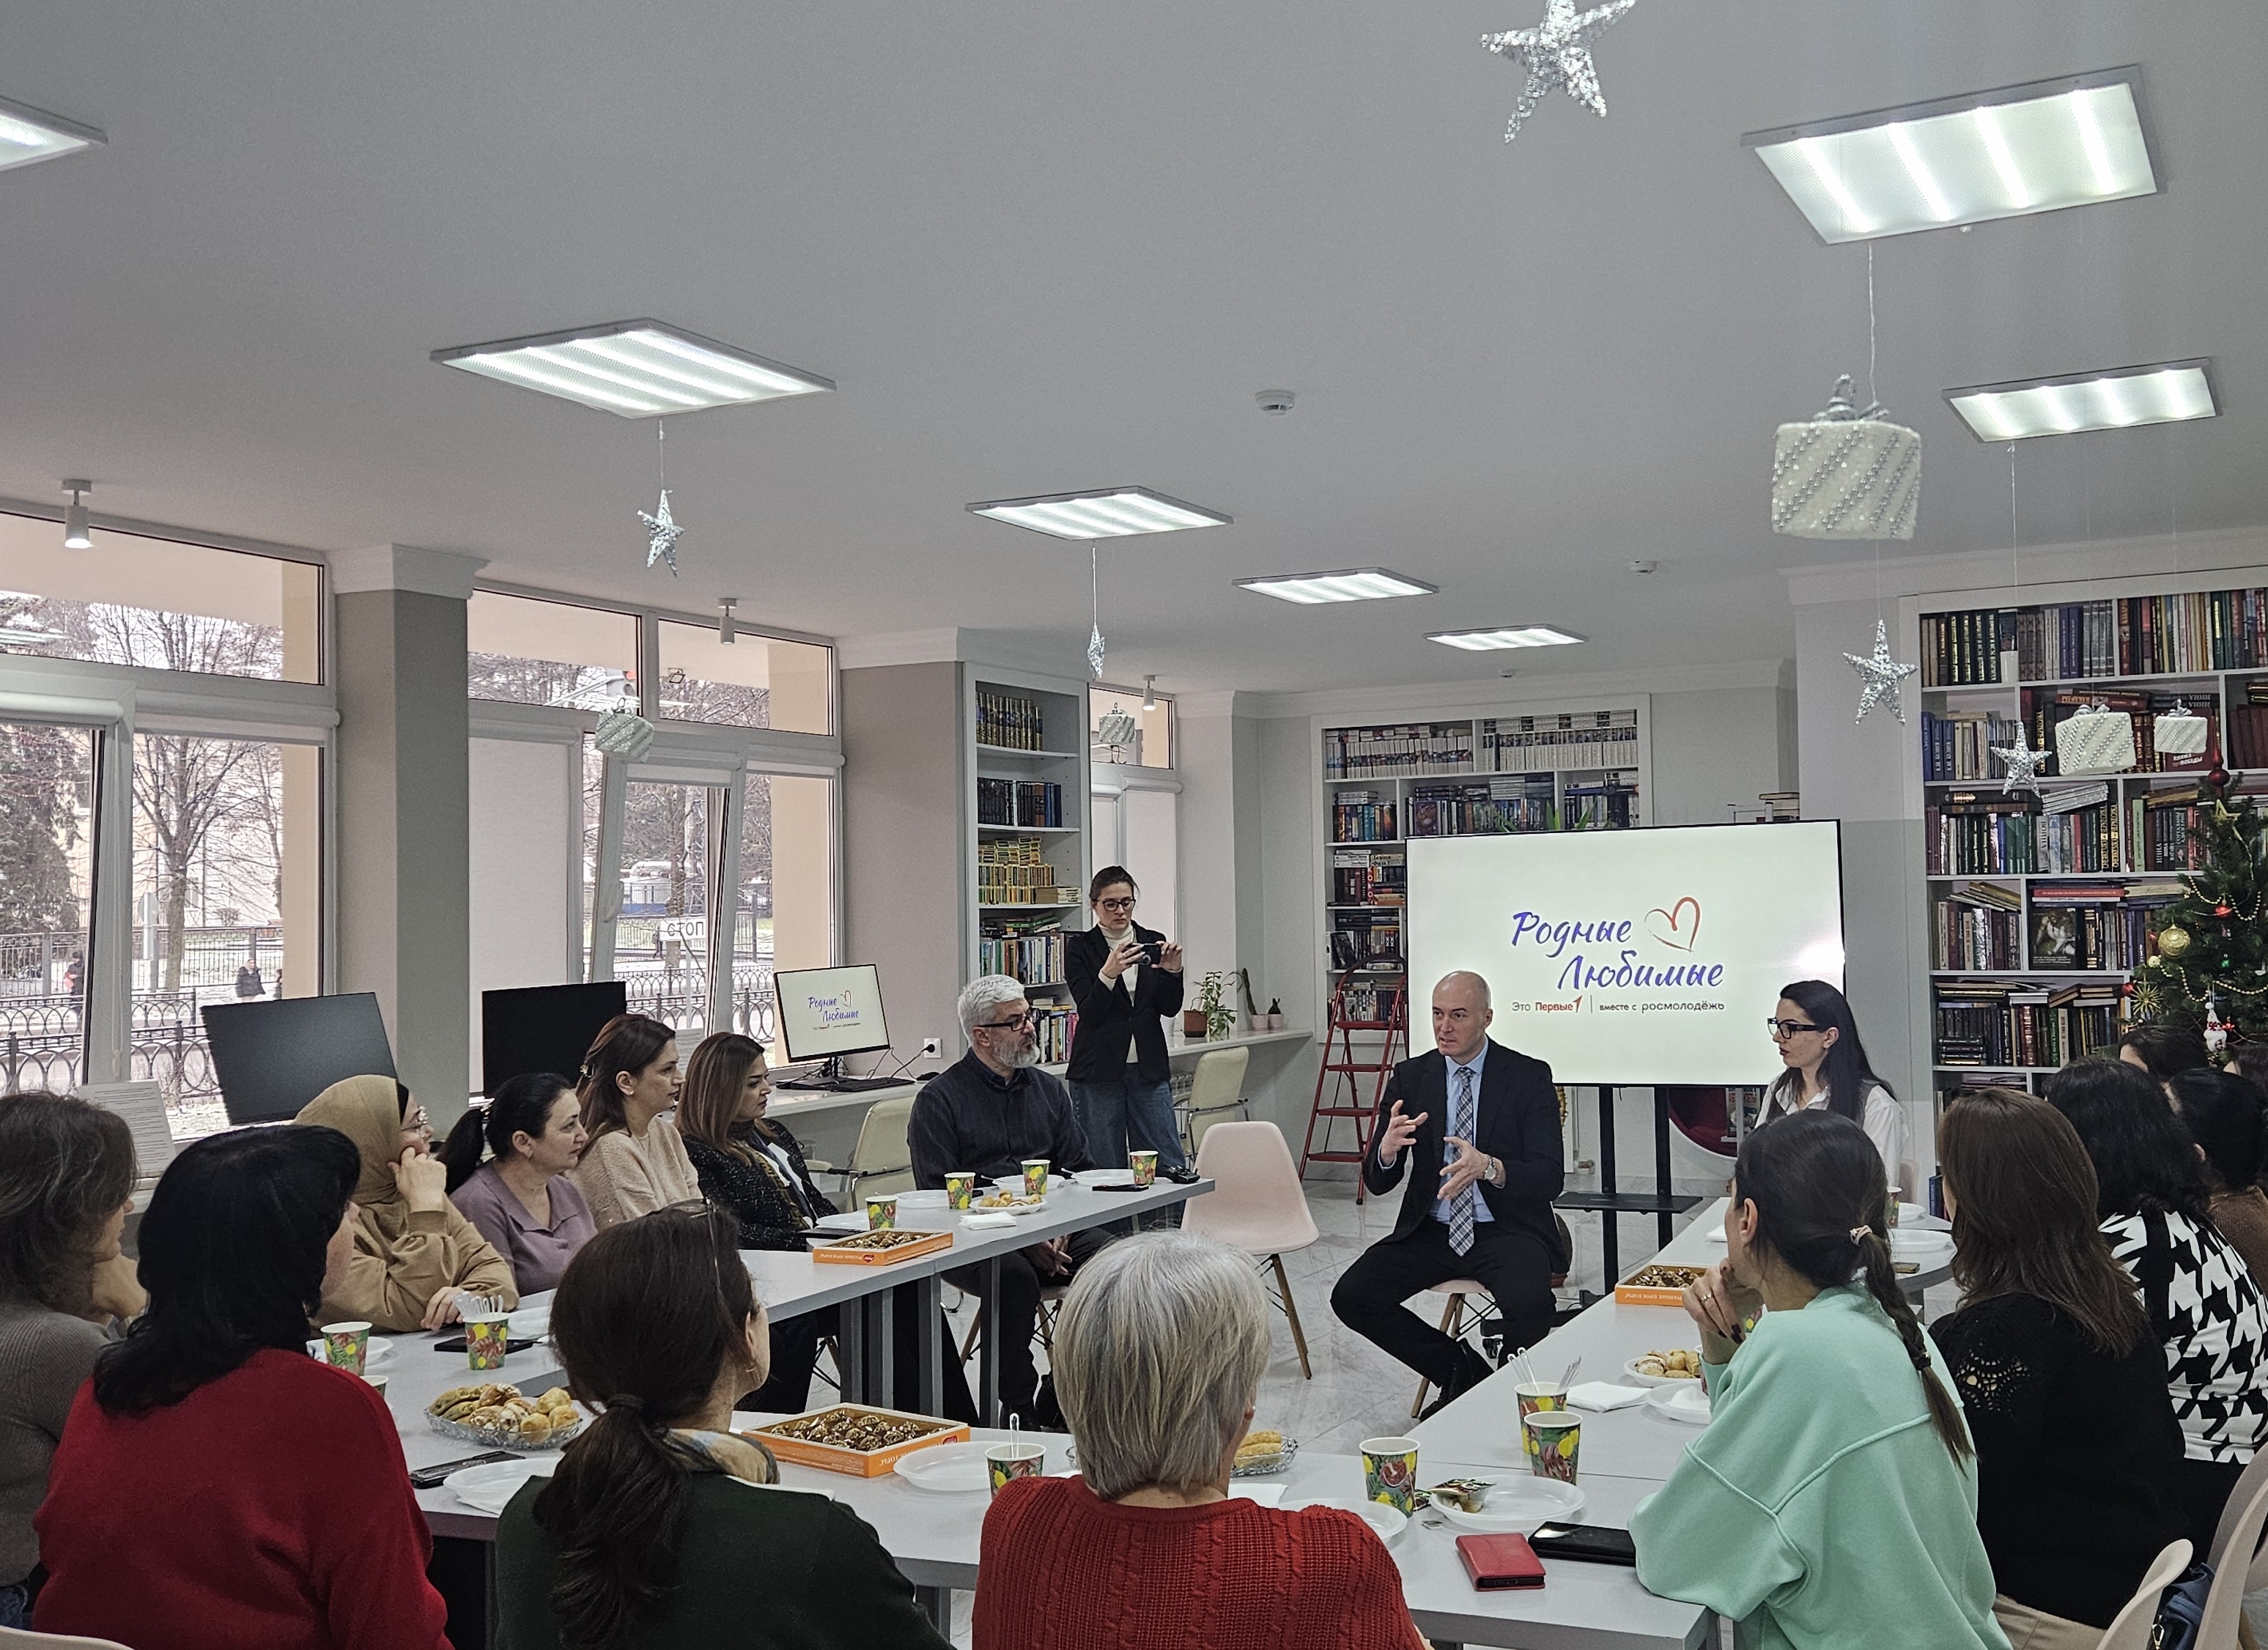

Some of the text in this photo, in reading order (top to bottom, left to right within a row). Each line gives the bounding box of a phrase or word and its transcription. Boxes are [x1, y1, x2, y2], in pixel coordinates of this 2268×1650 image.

[667, 921, 704, 936] СТОП
[1511, 911, 1632, 958] Родные
[1557, 950, 1724, 991] Любимые
[808, 996, 838, 1013] Родные
[1511, 1001, 1532, 1013] Это
[1534, 1001, 1573, 1013] Первые
[1599, 1003, 1629, 1012] вместе
[1631, 1004, 1637, 1012] с
[1641, 1000, 1725, 1015] росмолодёжь
[822, 1008, 860, 1023] Любимые
